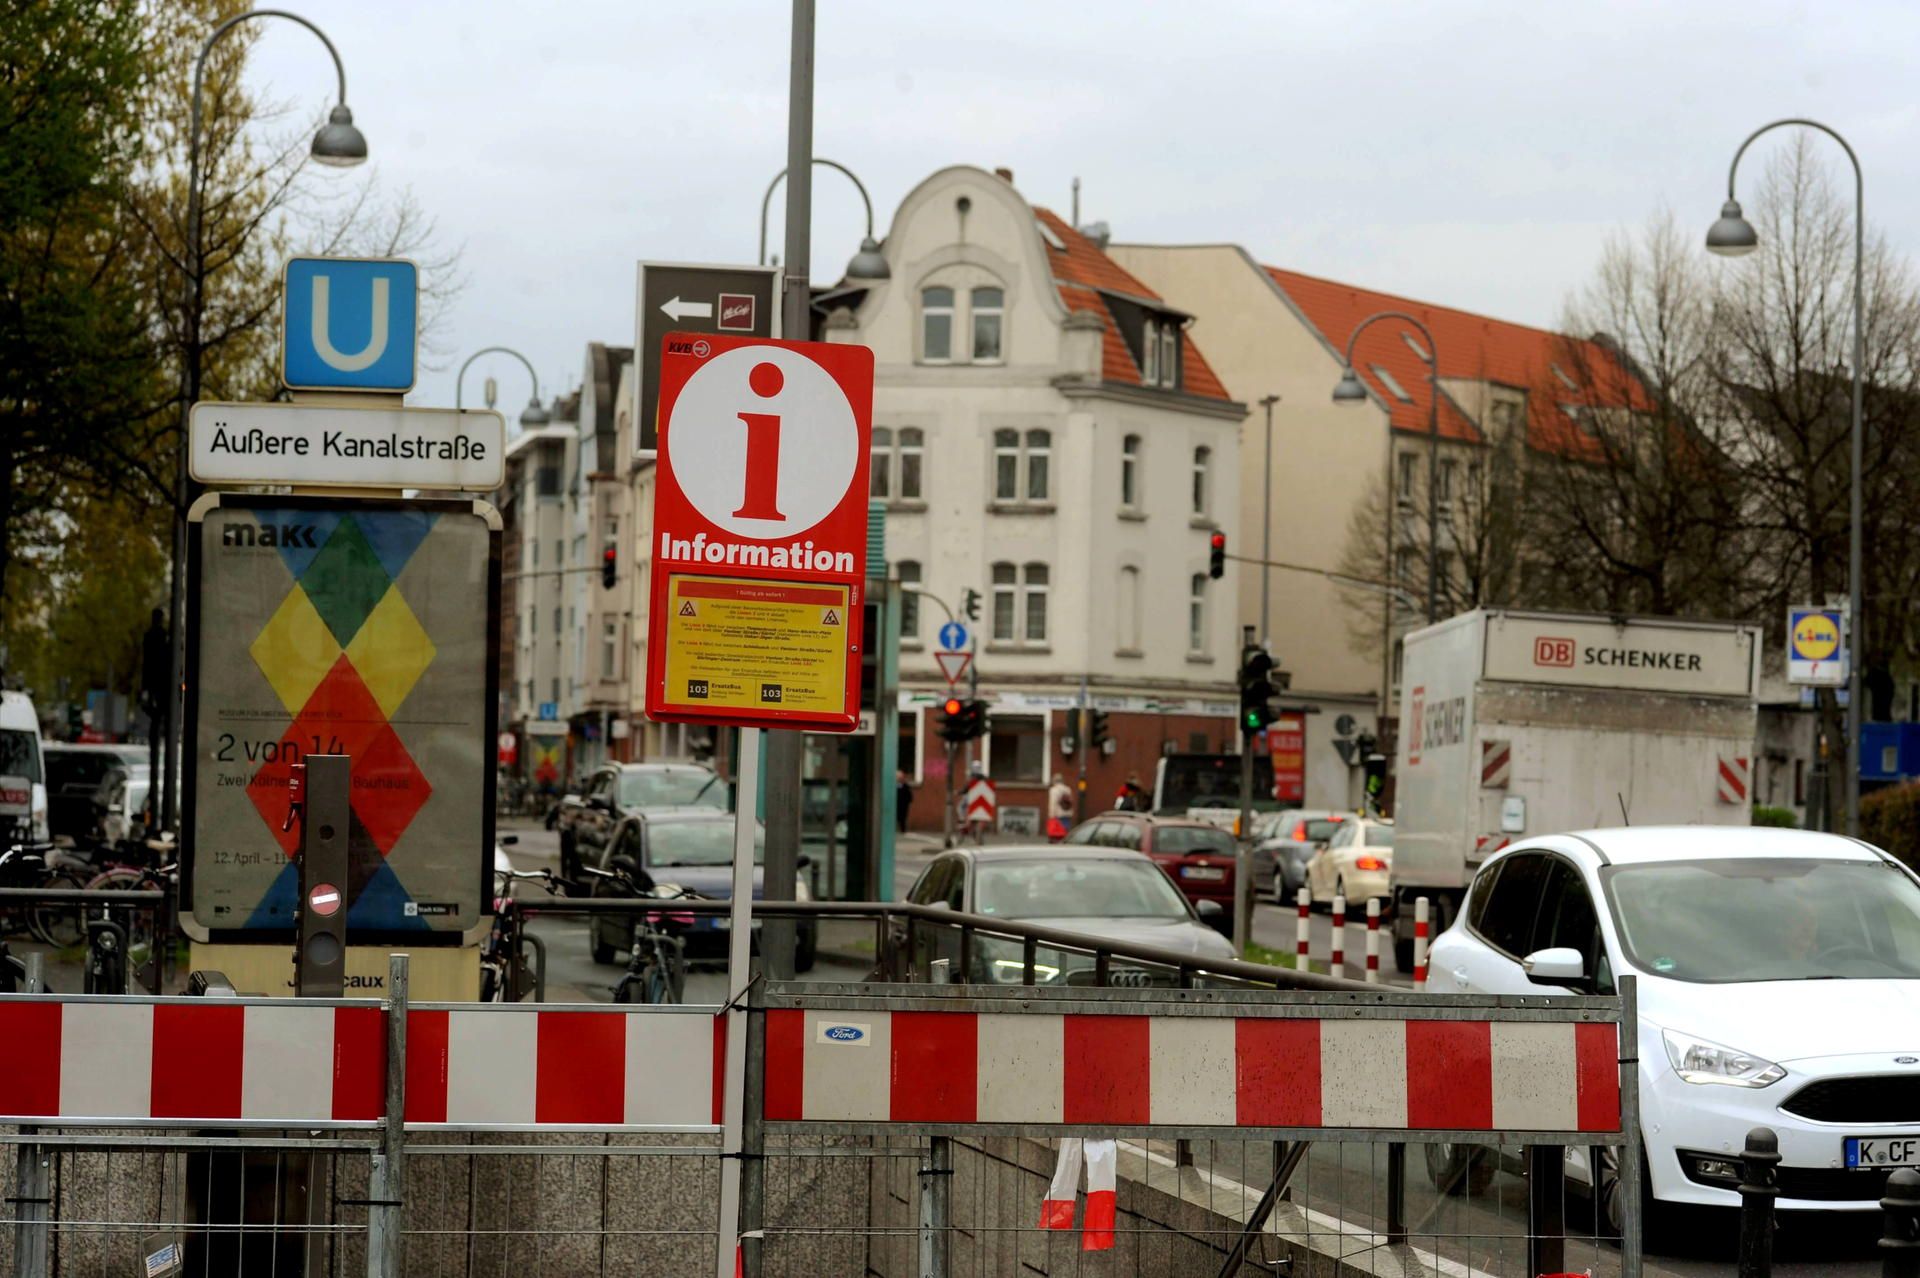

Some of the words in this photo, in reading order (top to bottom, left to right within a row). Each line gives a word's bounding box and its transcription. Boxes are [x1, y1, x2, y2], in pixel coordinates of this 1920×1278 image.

[311, 275, 390, 372] U
[668, 341, 693, 353] KVB
[210, 422, 310, 455] Äußere
[323, 431, 486, 461] Kanalstraße
[660, 532, 855, 574] Information
[1539, 642, 1570, 664] DB
[1584, 646, 1702, 671] SCHENKER
[689, 685, 708, 694] 103
[762, 689, 781, 698] 103
[217, 733, 235, 762] 2
[244, 741, 299, 764] von
[217, 773, 246, 787] Zwei
[234, 852, 260, 867] April
[832, 1026, 856, 1039] Ford
[1860, 1142, 1874, 1163] K
[1889, 1141, 1917, 1163] CF
